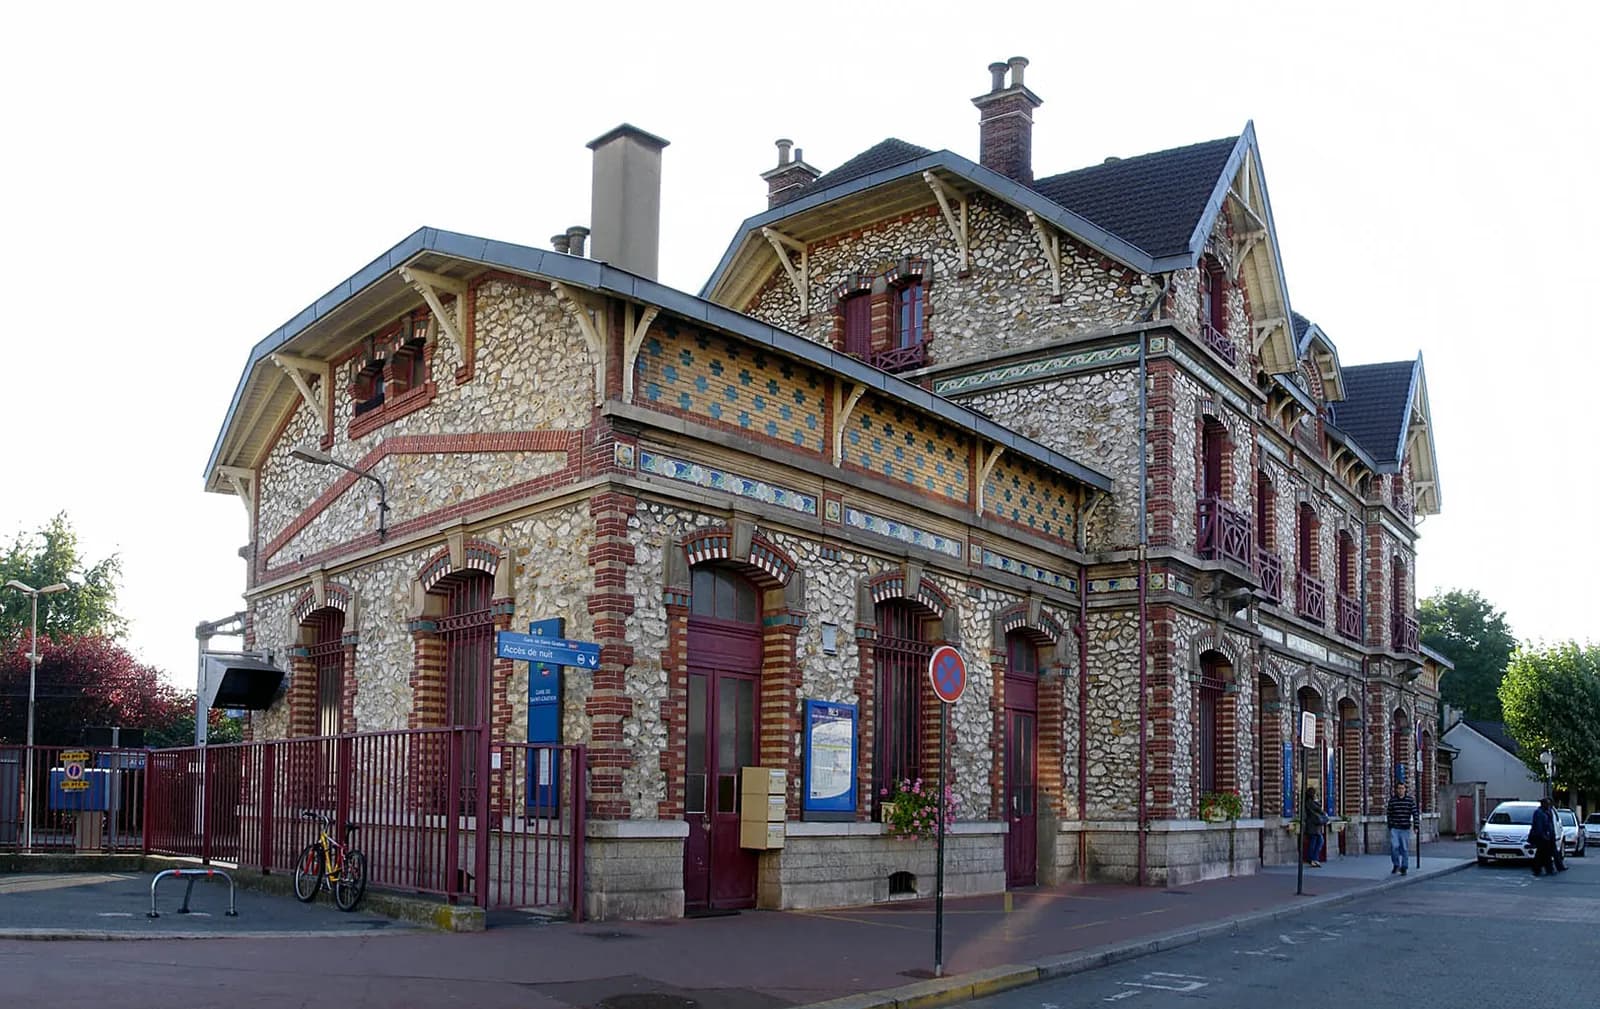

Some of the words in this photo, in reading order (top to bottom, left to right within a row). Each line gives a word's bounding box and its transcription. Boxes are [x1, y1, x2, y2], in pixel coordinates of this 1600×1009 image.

[504, 645, 525, 655] Accès
[527, 648, 537, 656] de
[539, 650, 553, 658] nuit
